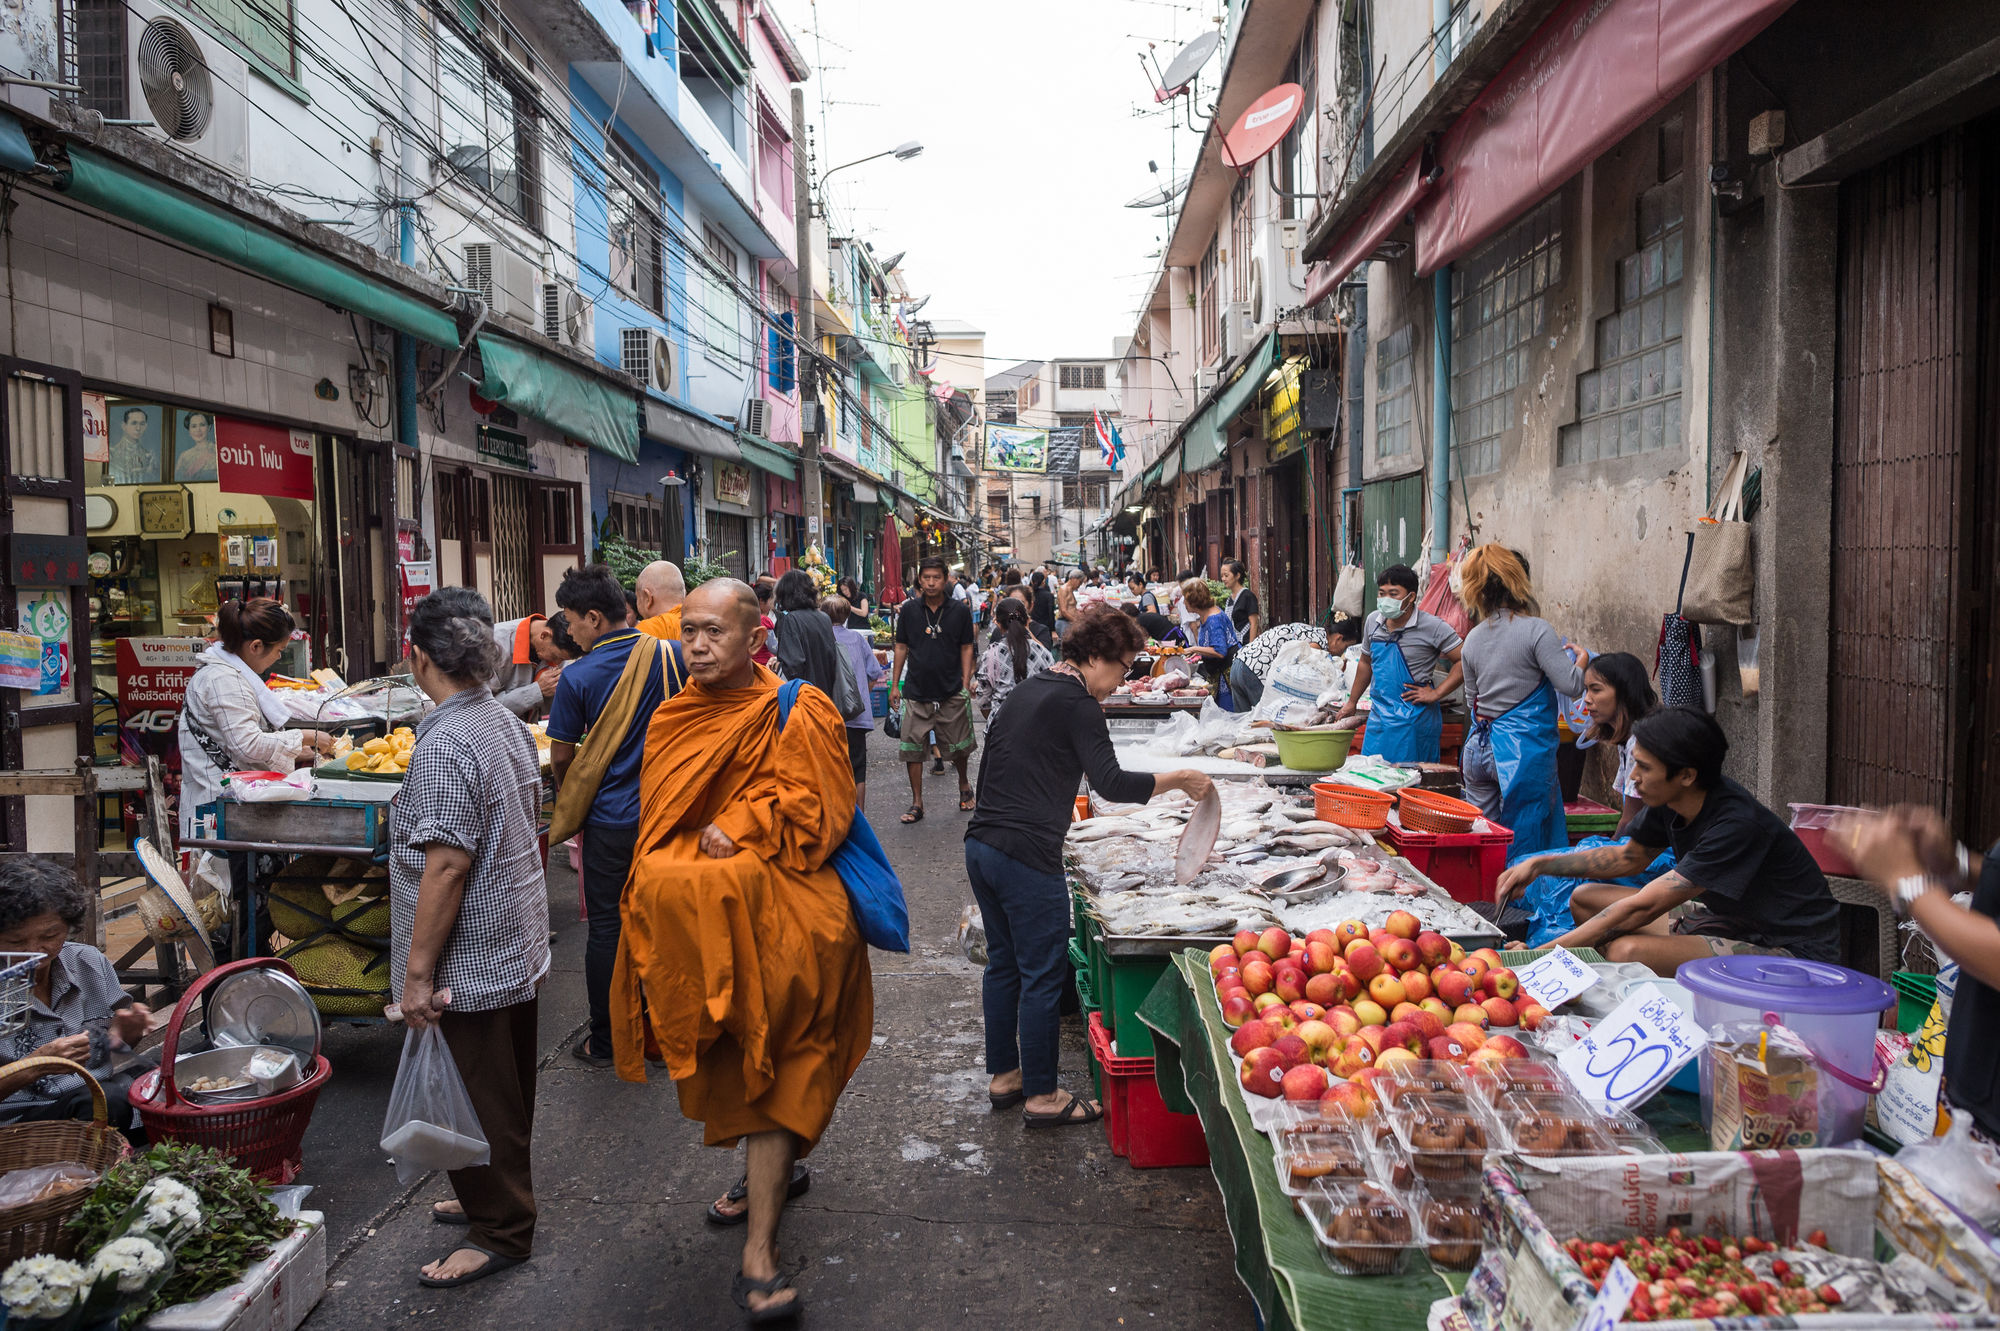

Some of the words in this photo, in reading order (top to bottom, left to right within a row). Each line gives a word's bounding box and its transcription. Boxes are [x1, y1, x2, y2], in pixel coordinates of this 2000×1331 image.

[82, 409, 108, 437] งิน
[293, 436, 310, 449] true
[220, 443, 254, 466] อาม่า
[259, 445, 283, 470] โฟน
[127, 674, 149, 687] 4G
[156, 670, 192, 688] ที่ดีที่ส
[1586, 1022, 1672, 1101] 50
[1743, 1113, 1813, 1149] Coffee
